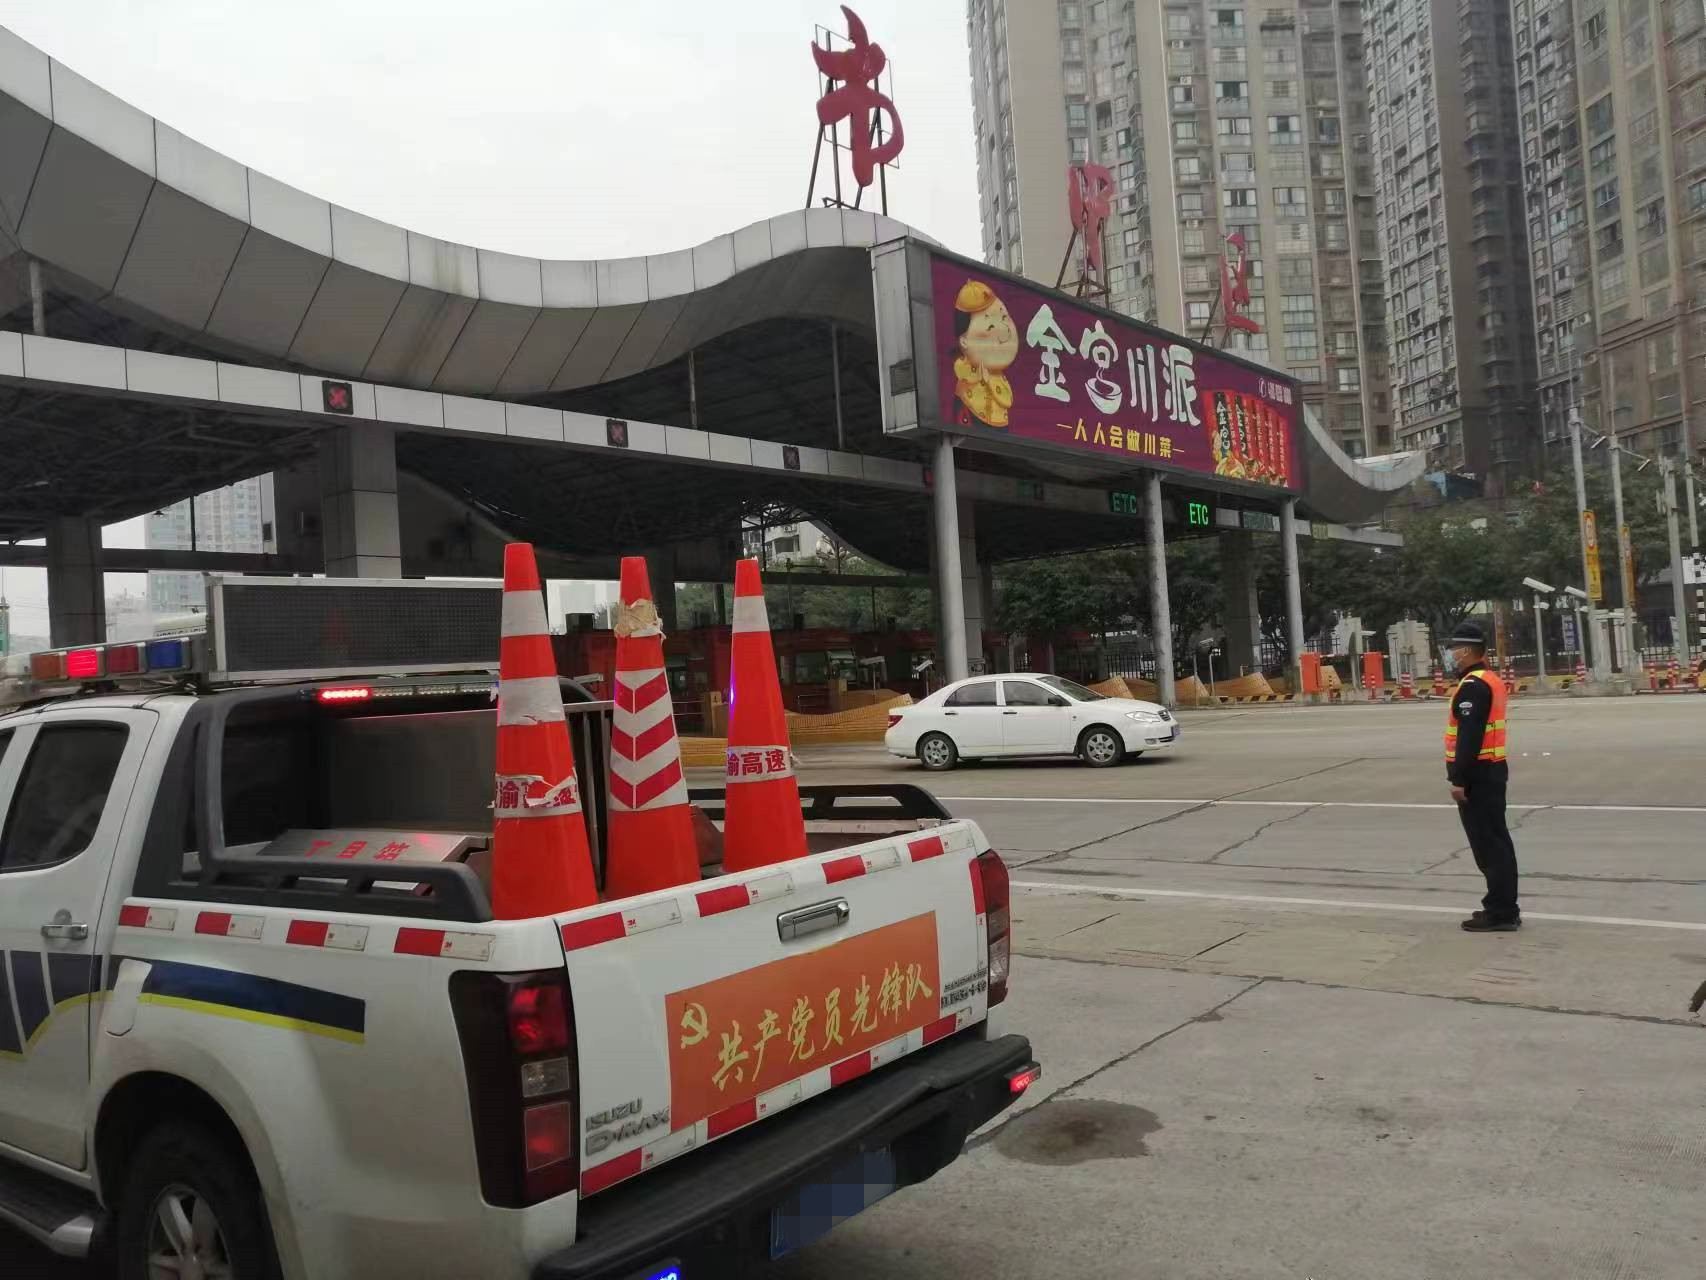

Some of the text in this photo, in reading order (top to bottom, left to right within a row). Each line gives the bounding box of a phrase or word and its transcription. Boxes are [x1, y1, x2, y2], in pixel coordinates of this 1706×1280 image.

[1027, 303, 1200, 426] 金宫川派
[1074, 417, 1171, 458] 人人会做川菜
[1113, 491, 1137, 514] ETC
[1189, 502, 1209, 525] ETC
[711, 961, 933, 1092] 共产党员先锋队
[586, 1097, 642, 1133] ISUZU
